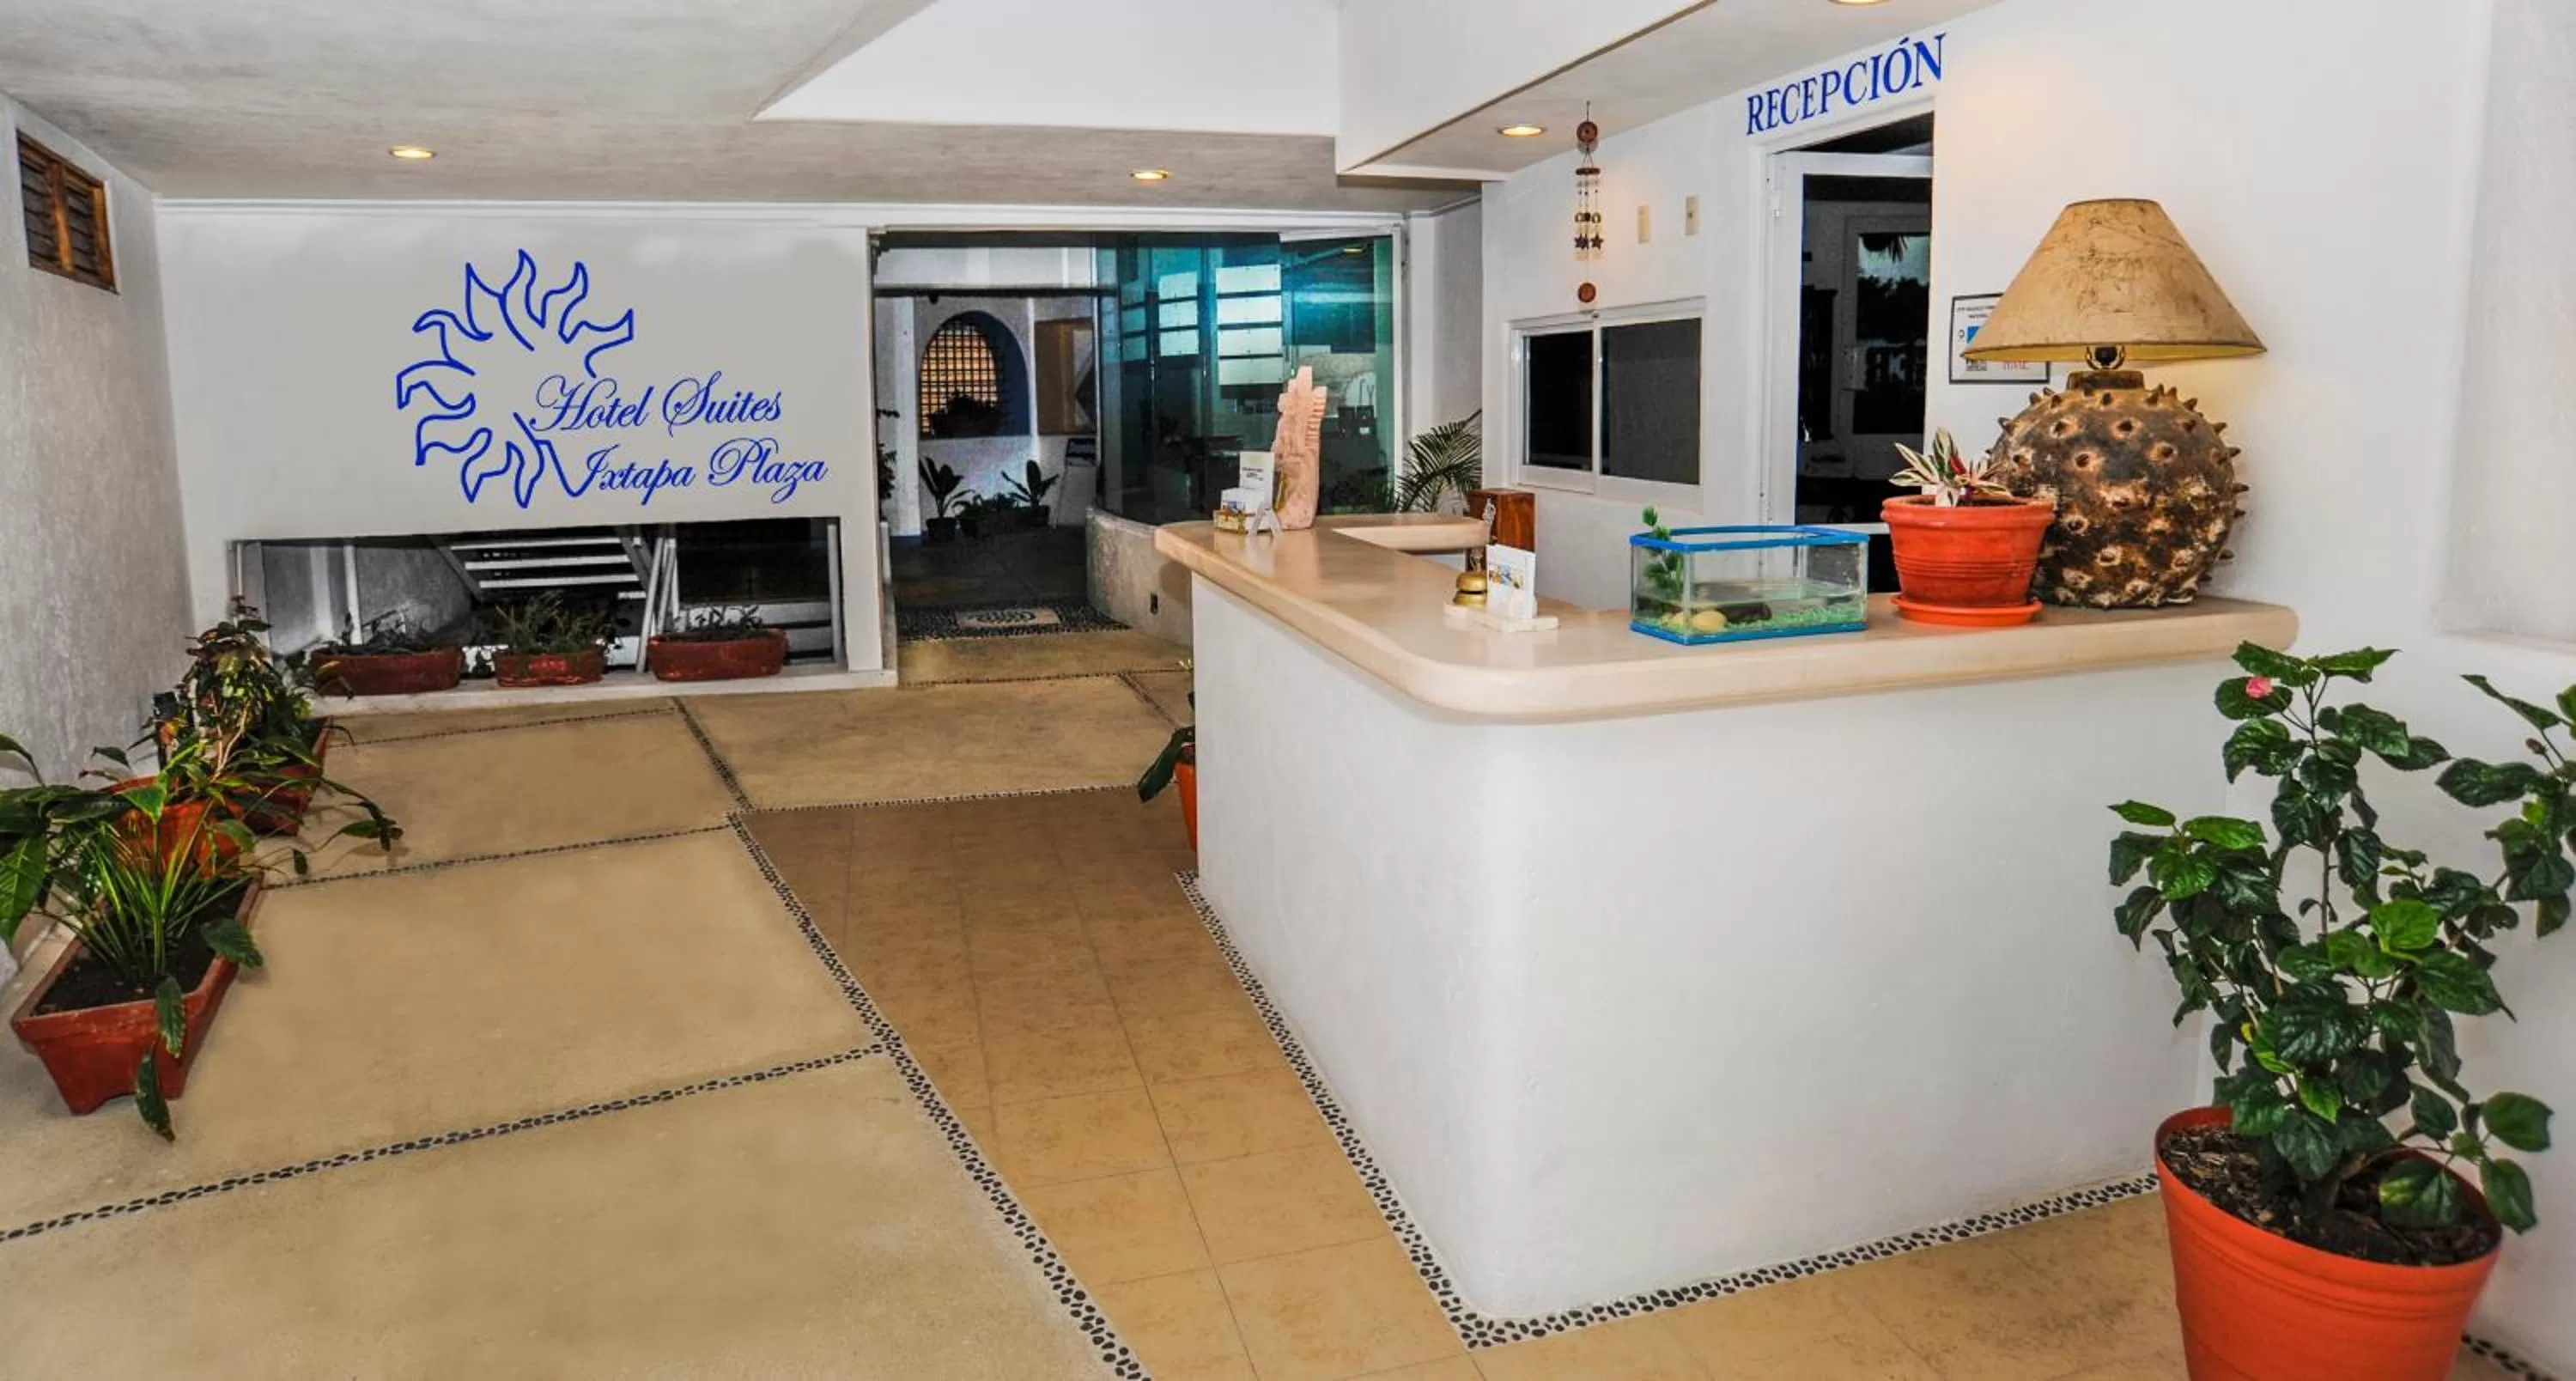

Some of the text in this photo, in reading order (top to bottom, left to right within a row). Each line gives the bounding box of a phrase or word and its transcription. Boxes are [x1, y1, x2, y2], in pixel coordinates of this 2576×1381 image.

[1746, 32, 1947, 136] RECEPCIÓN
[529, 371, 783, 437] Hotel Suites
[585, 437, 828, 505] Ixtapa Plaza
